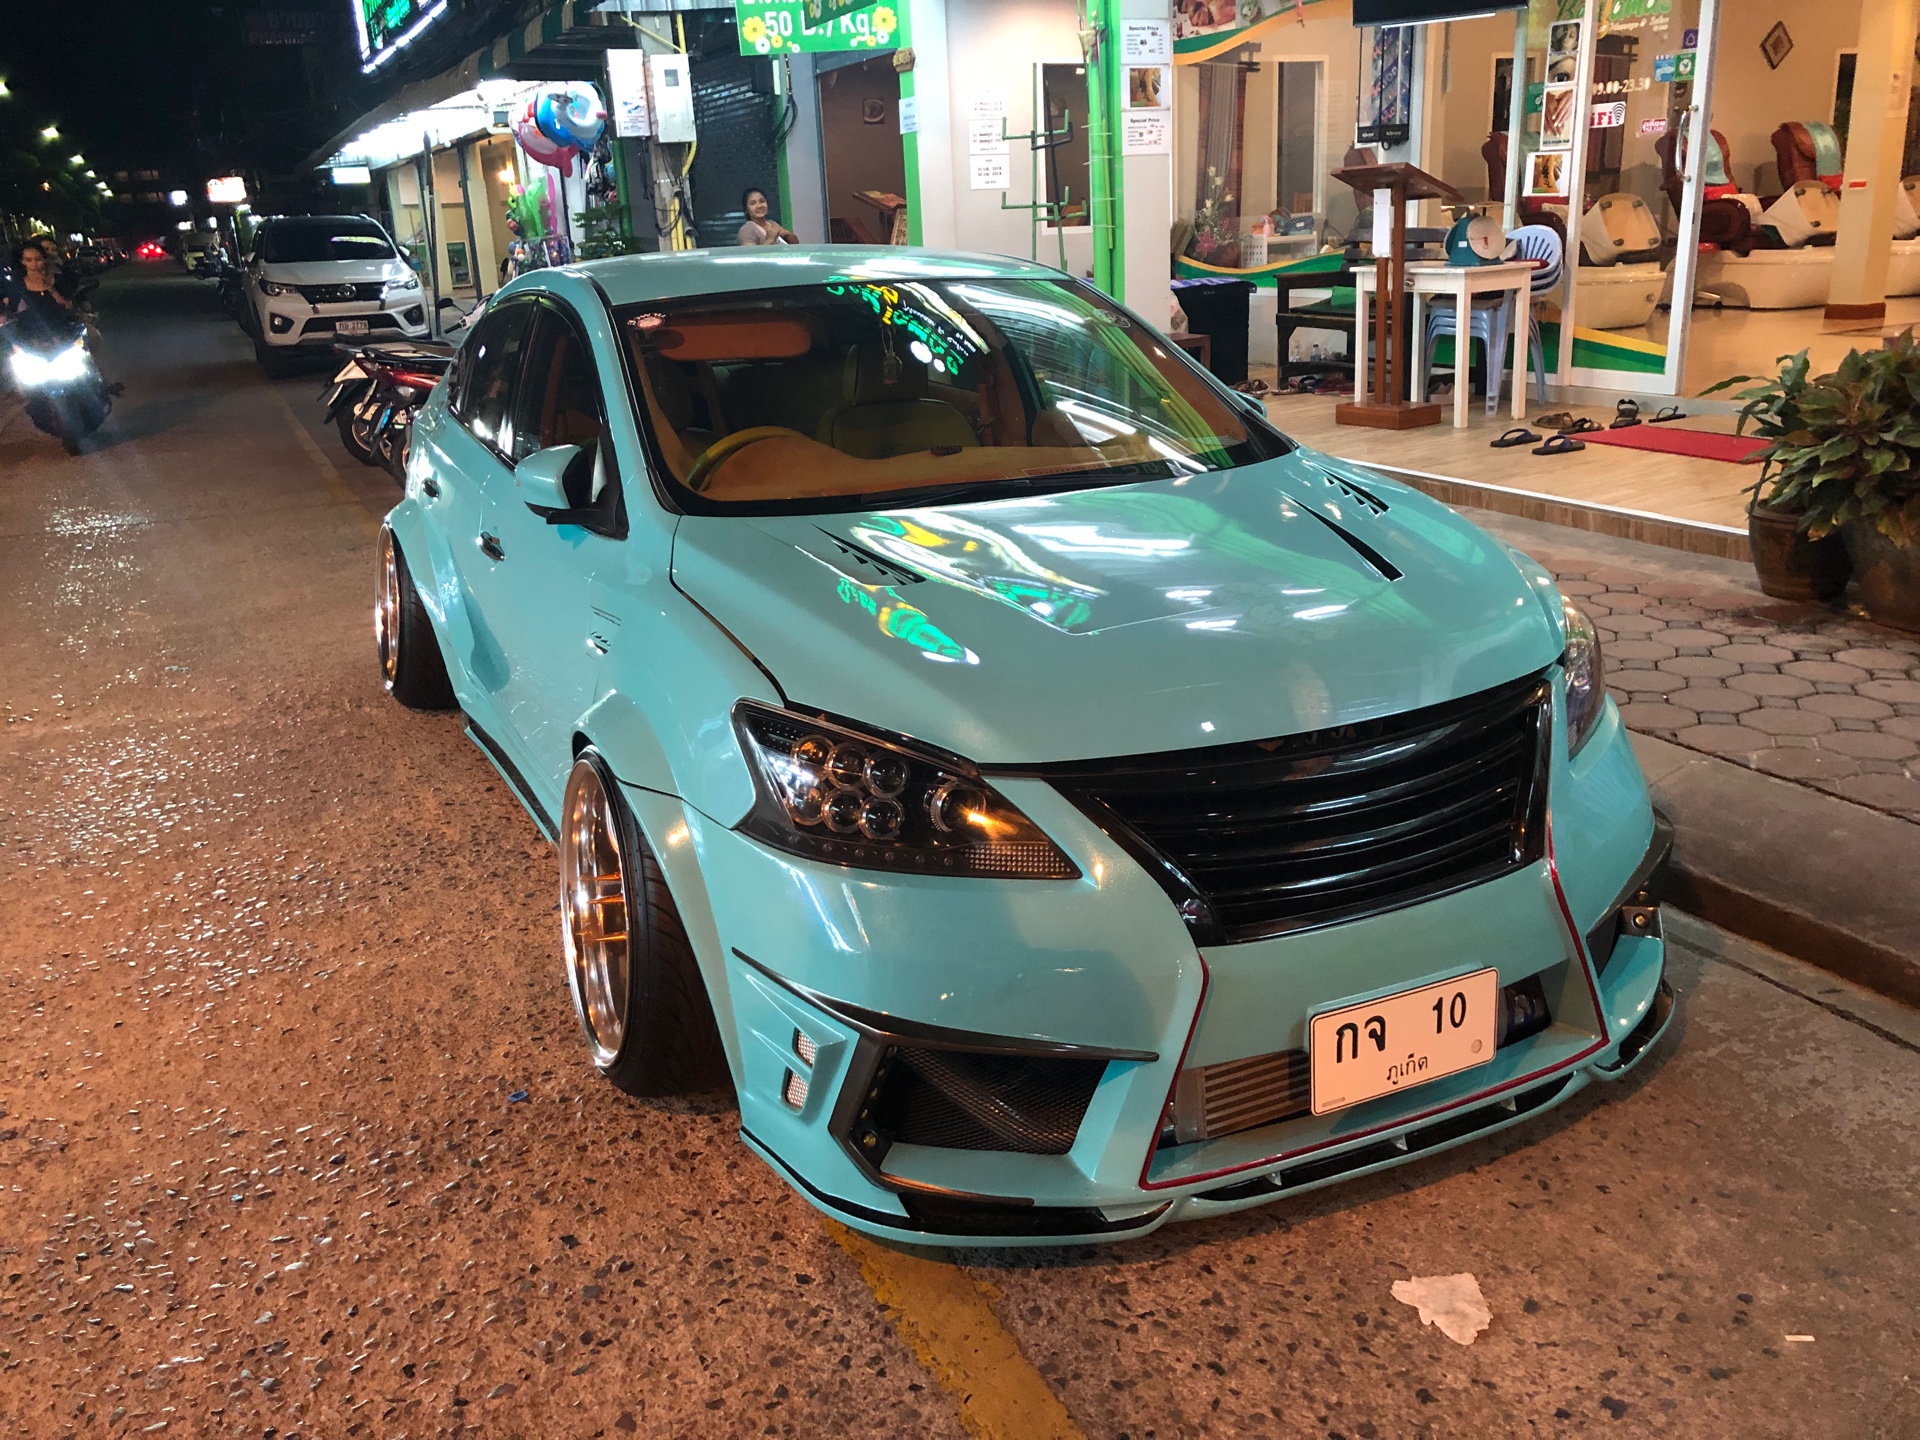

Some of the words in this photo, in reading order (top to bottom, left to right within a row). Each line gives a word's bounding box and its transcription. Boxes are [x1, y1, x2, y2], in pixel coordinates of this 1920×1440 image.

[764, 10, 793, 37] 50
[1590, 112, 1613, 127] iFi
[1335, 1014, 1388, 1064] กจ
[1432, 991, 1468, 1034] 10
[1386, 1052, 1429, 1085] ภูเก็ต
